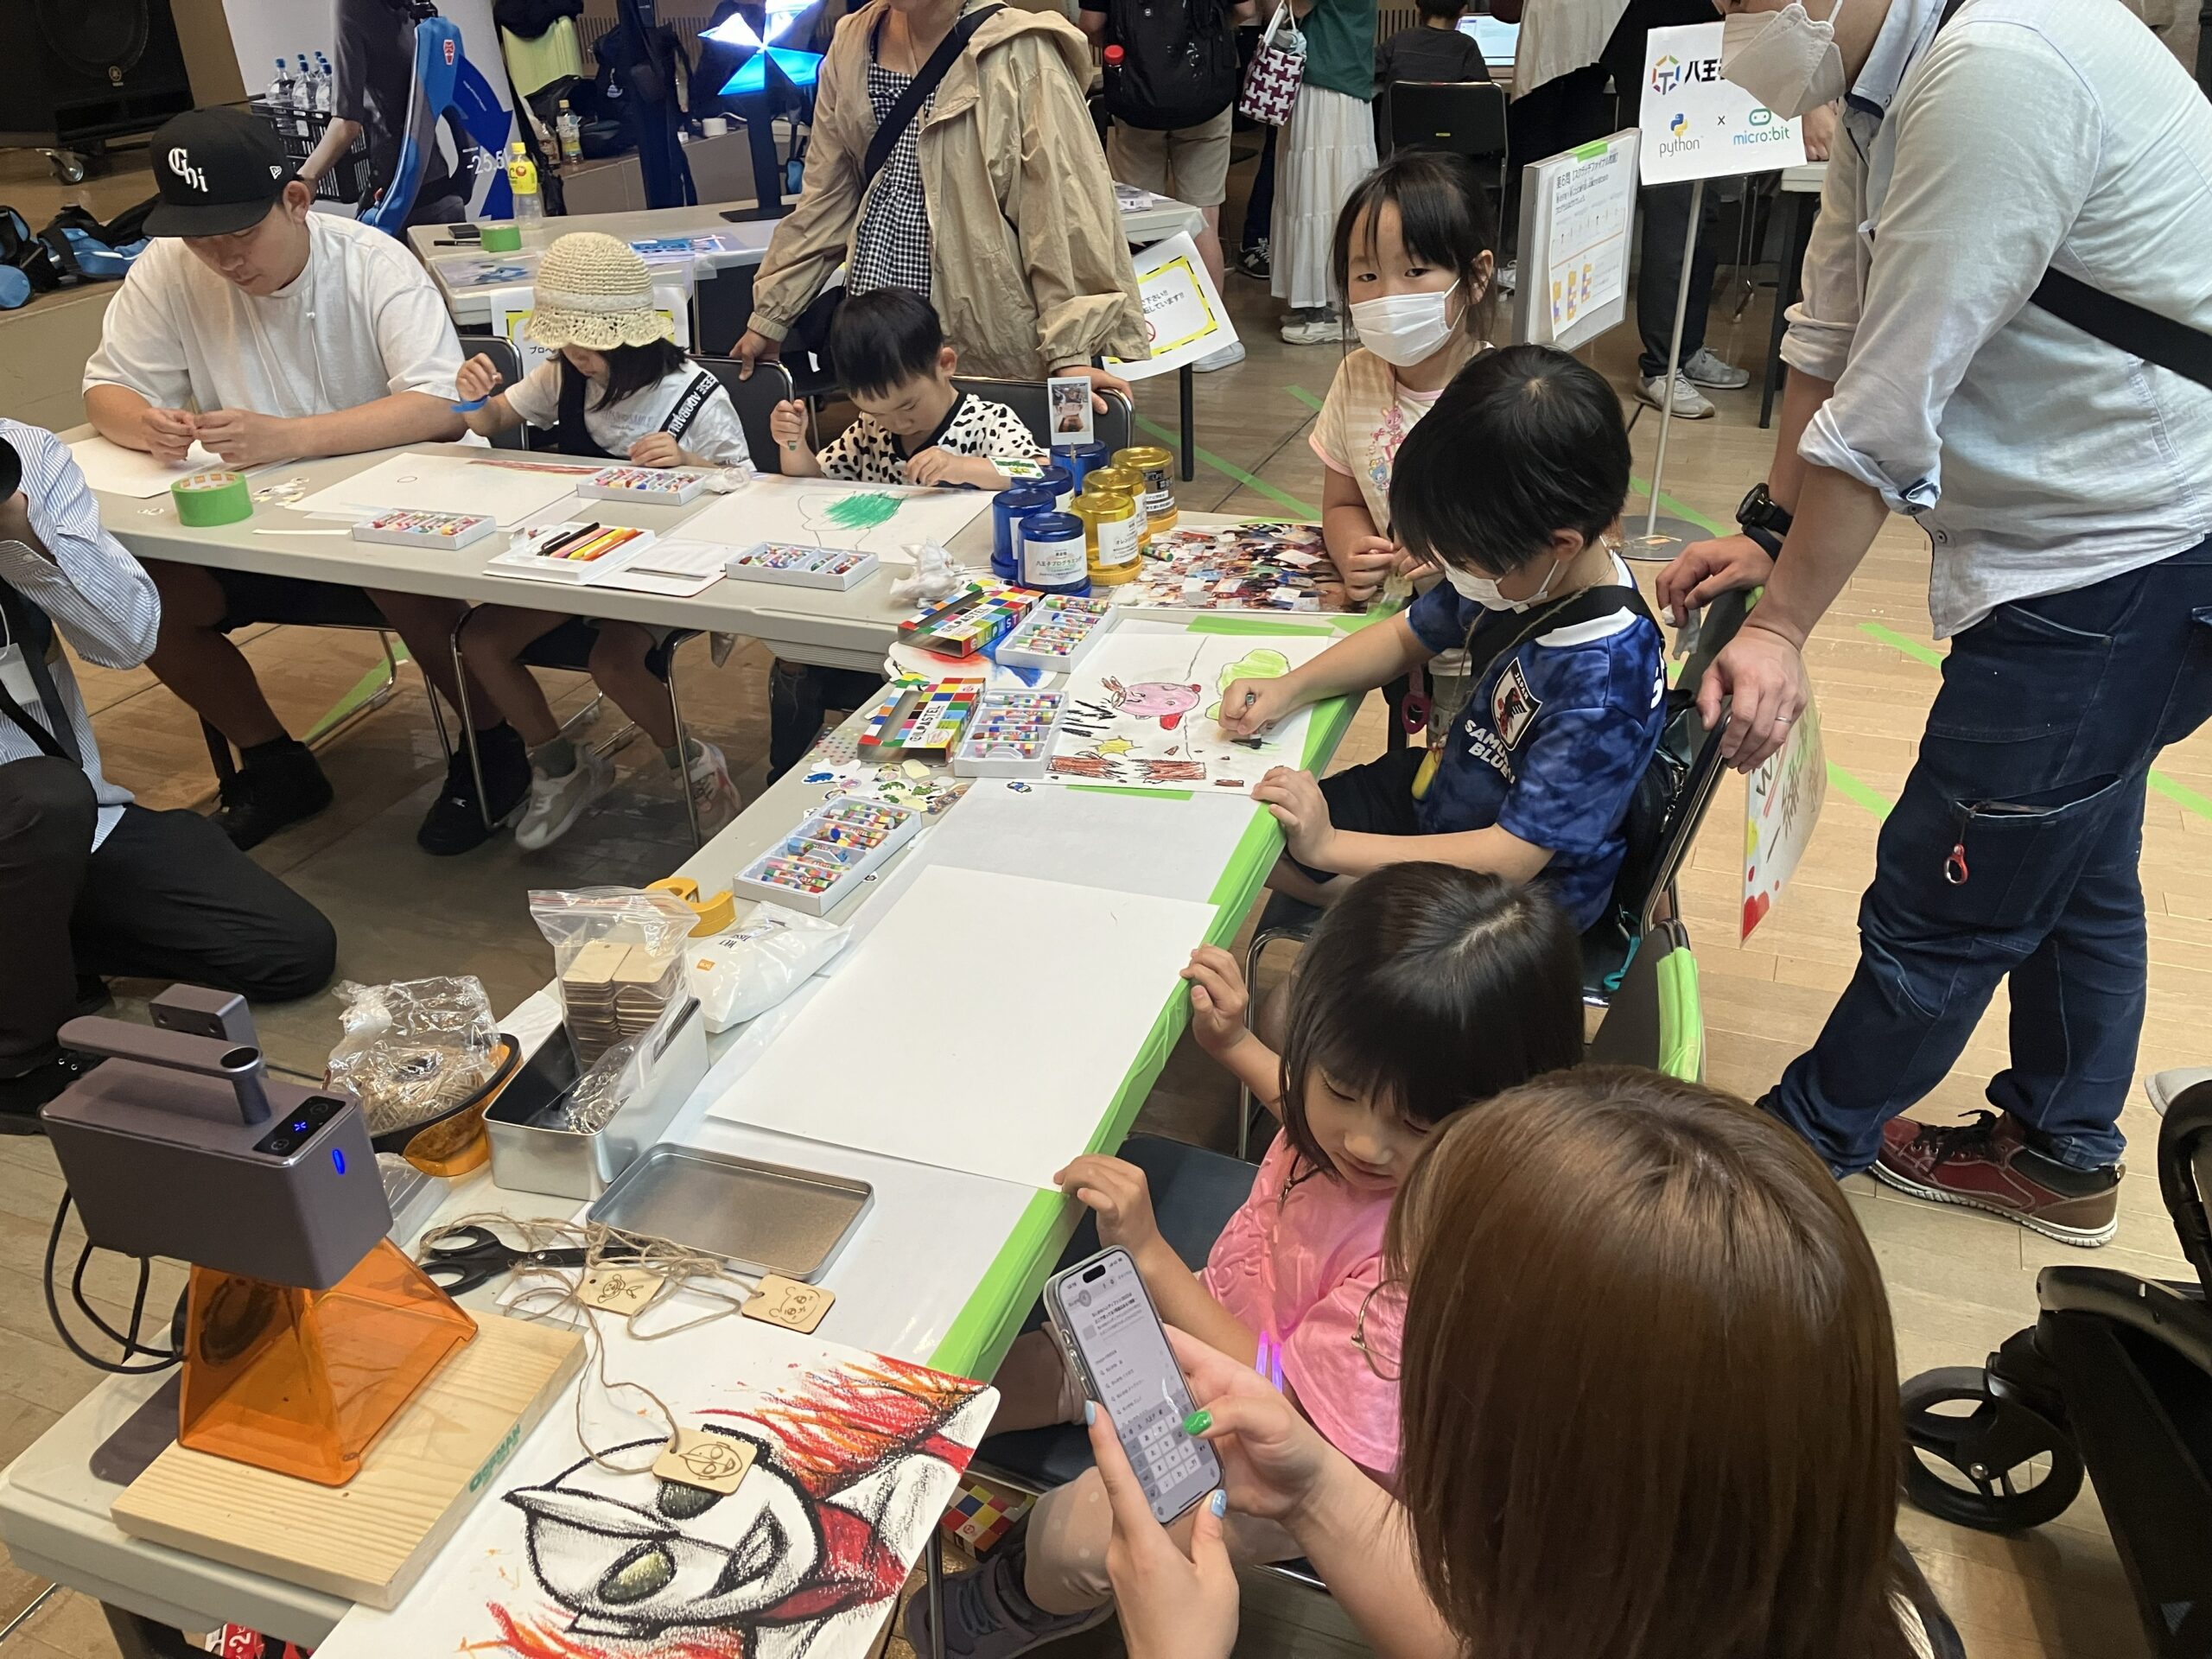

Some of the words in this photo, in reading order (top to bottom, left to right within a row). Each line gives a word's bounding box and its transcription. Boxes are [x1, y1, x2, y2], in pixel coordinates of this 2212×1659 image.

[1684, 58, 1725, 84] 八王
[1659, 136, 1700, 158] python
[1732, 126, 1790, 145] micro:bit
[168, 147, 208, 193] Chi
[1514, 671, 1529, 701] JAPAN
